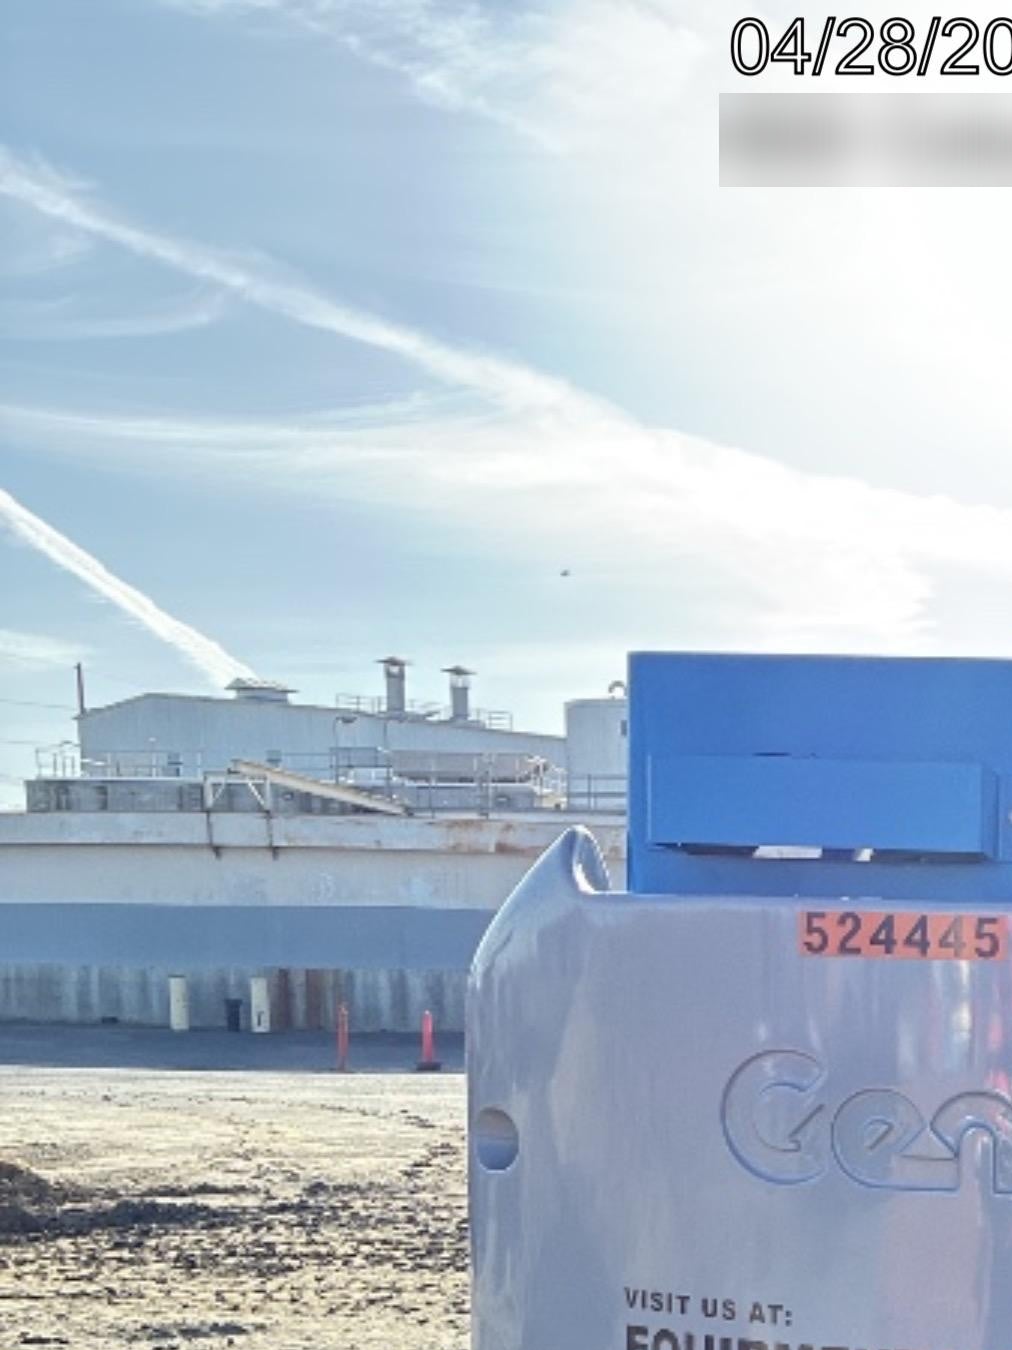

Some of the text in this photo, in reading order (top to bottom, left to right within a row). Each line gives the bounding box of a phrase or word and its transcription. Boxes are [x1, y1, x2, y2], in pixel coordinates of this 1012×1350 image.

[803, 911, 1000, 958] 524445
[624, 1287, 793, 1327] VISIT US AT:
